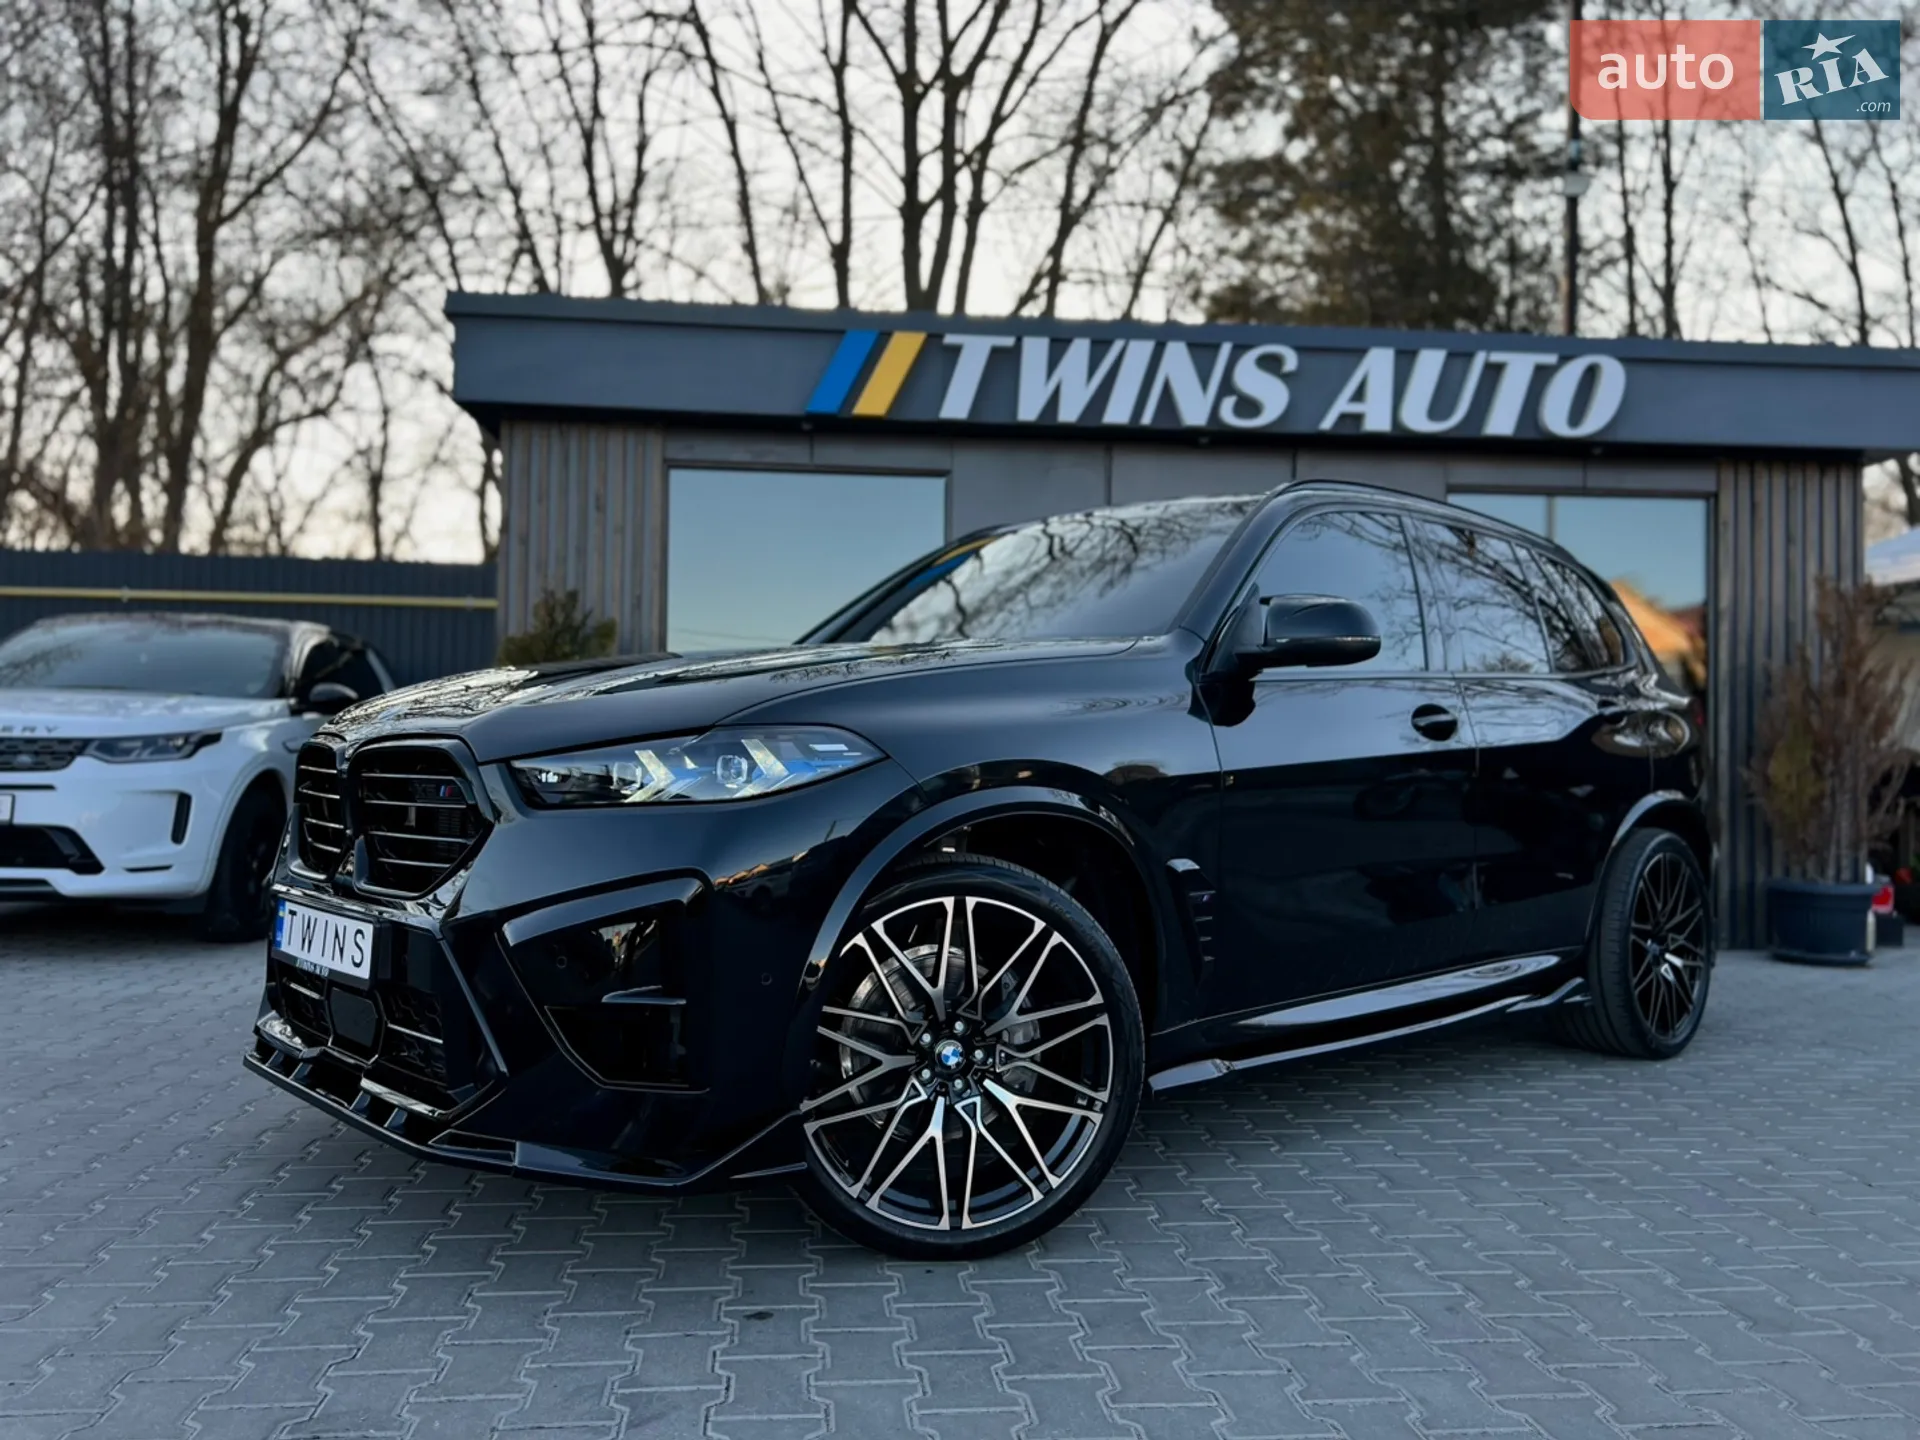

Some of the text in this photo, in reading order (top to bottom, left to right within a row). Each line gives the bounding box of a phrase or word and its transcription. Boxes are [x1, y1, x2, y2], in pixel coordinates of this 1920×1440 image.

[938, 333, 1627, 438] TWINS AUTO
[287, 908, 366, 969] TWINS
